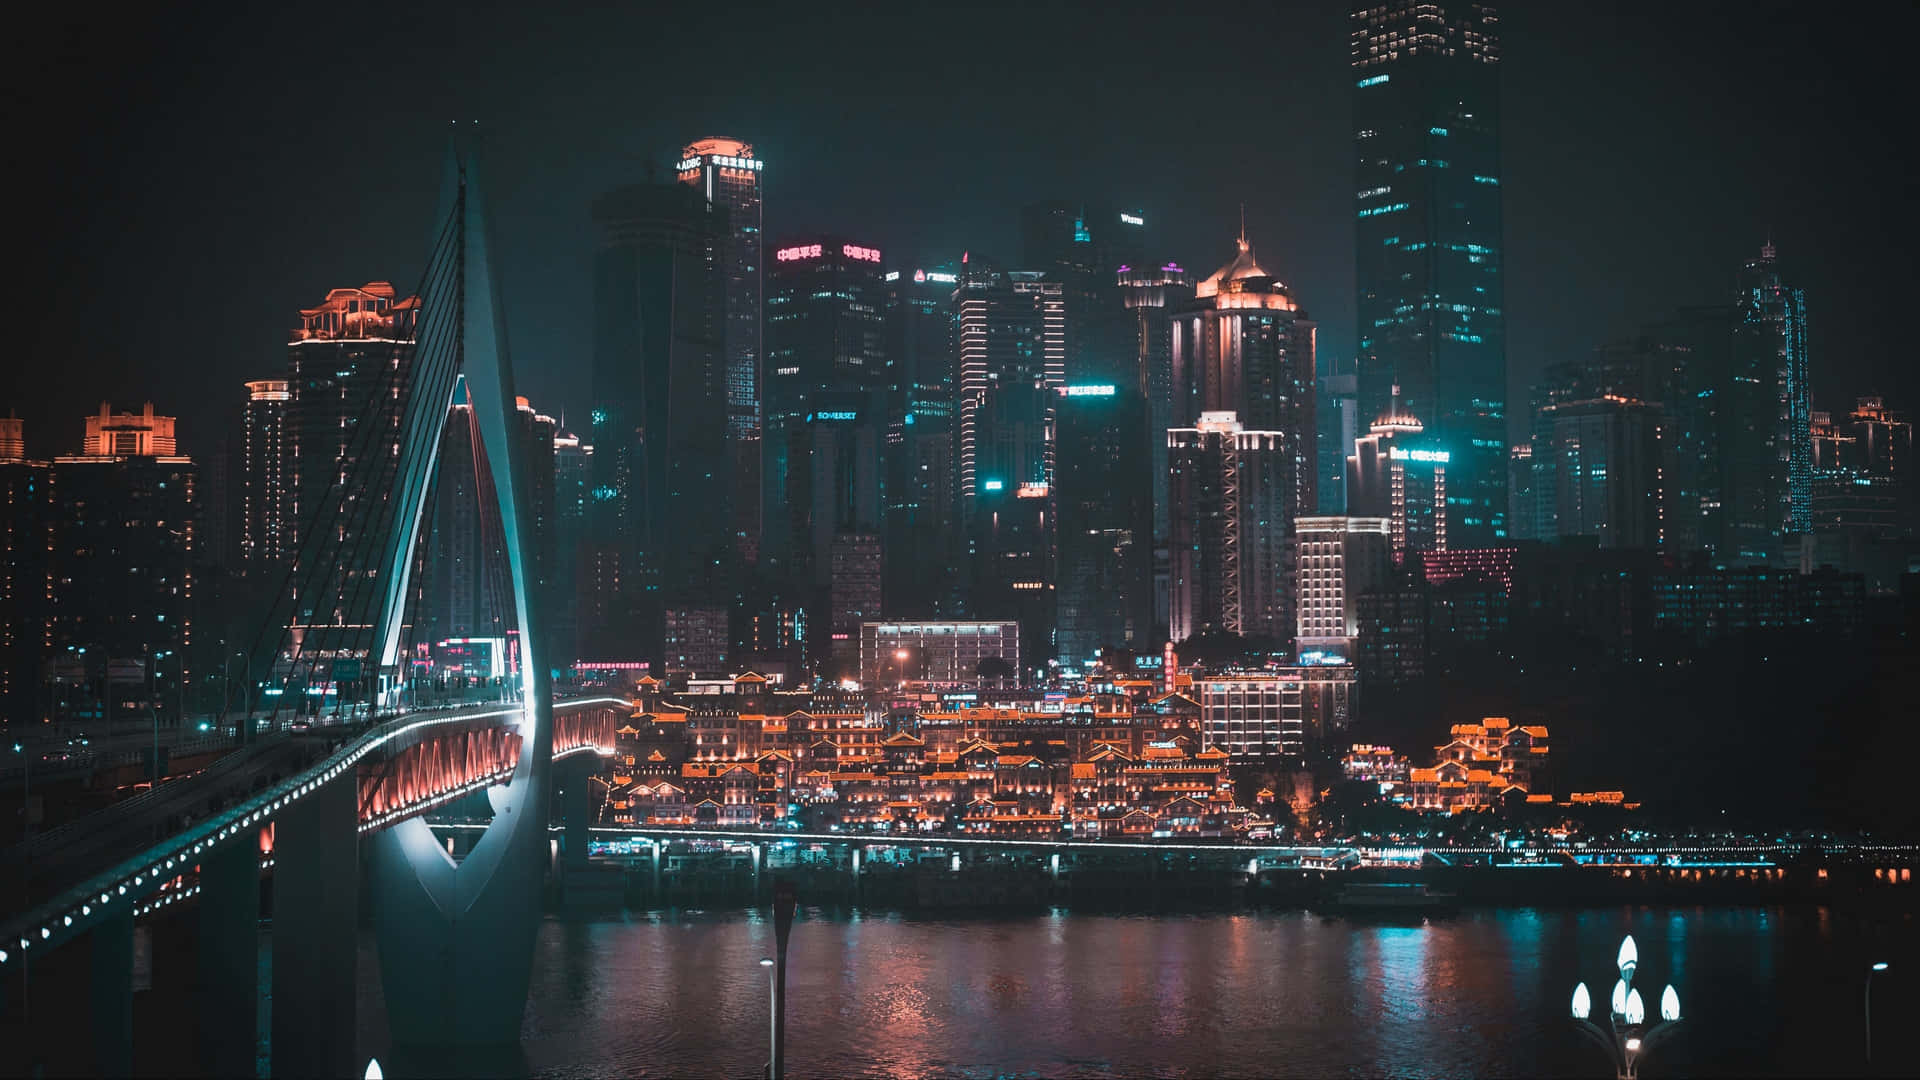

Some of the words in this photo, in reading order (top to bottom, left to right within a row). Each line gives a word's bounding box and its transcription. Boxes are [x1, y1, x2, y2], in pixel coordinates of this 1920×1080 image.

[777, 244, 822, 262] 中国平安
[843, 244, 880, 263] 中国平安
